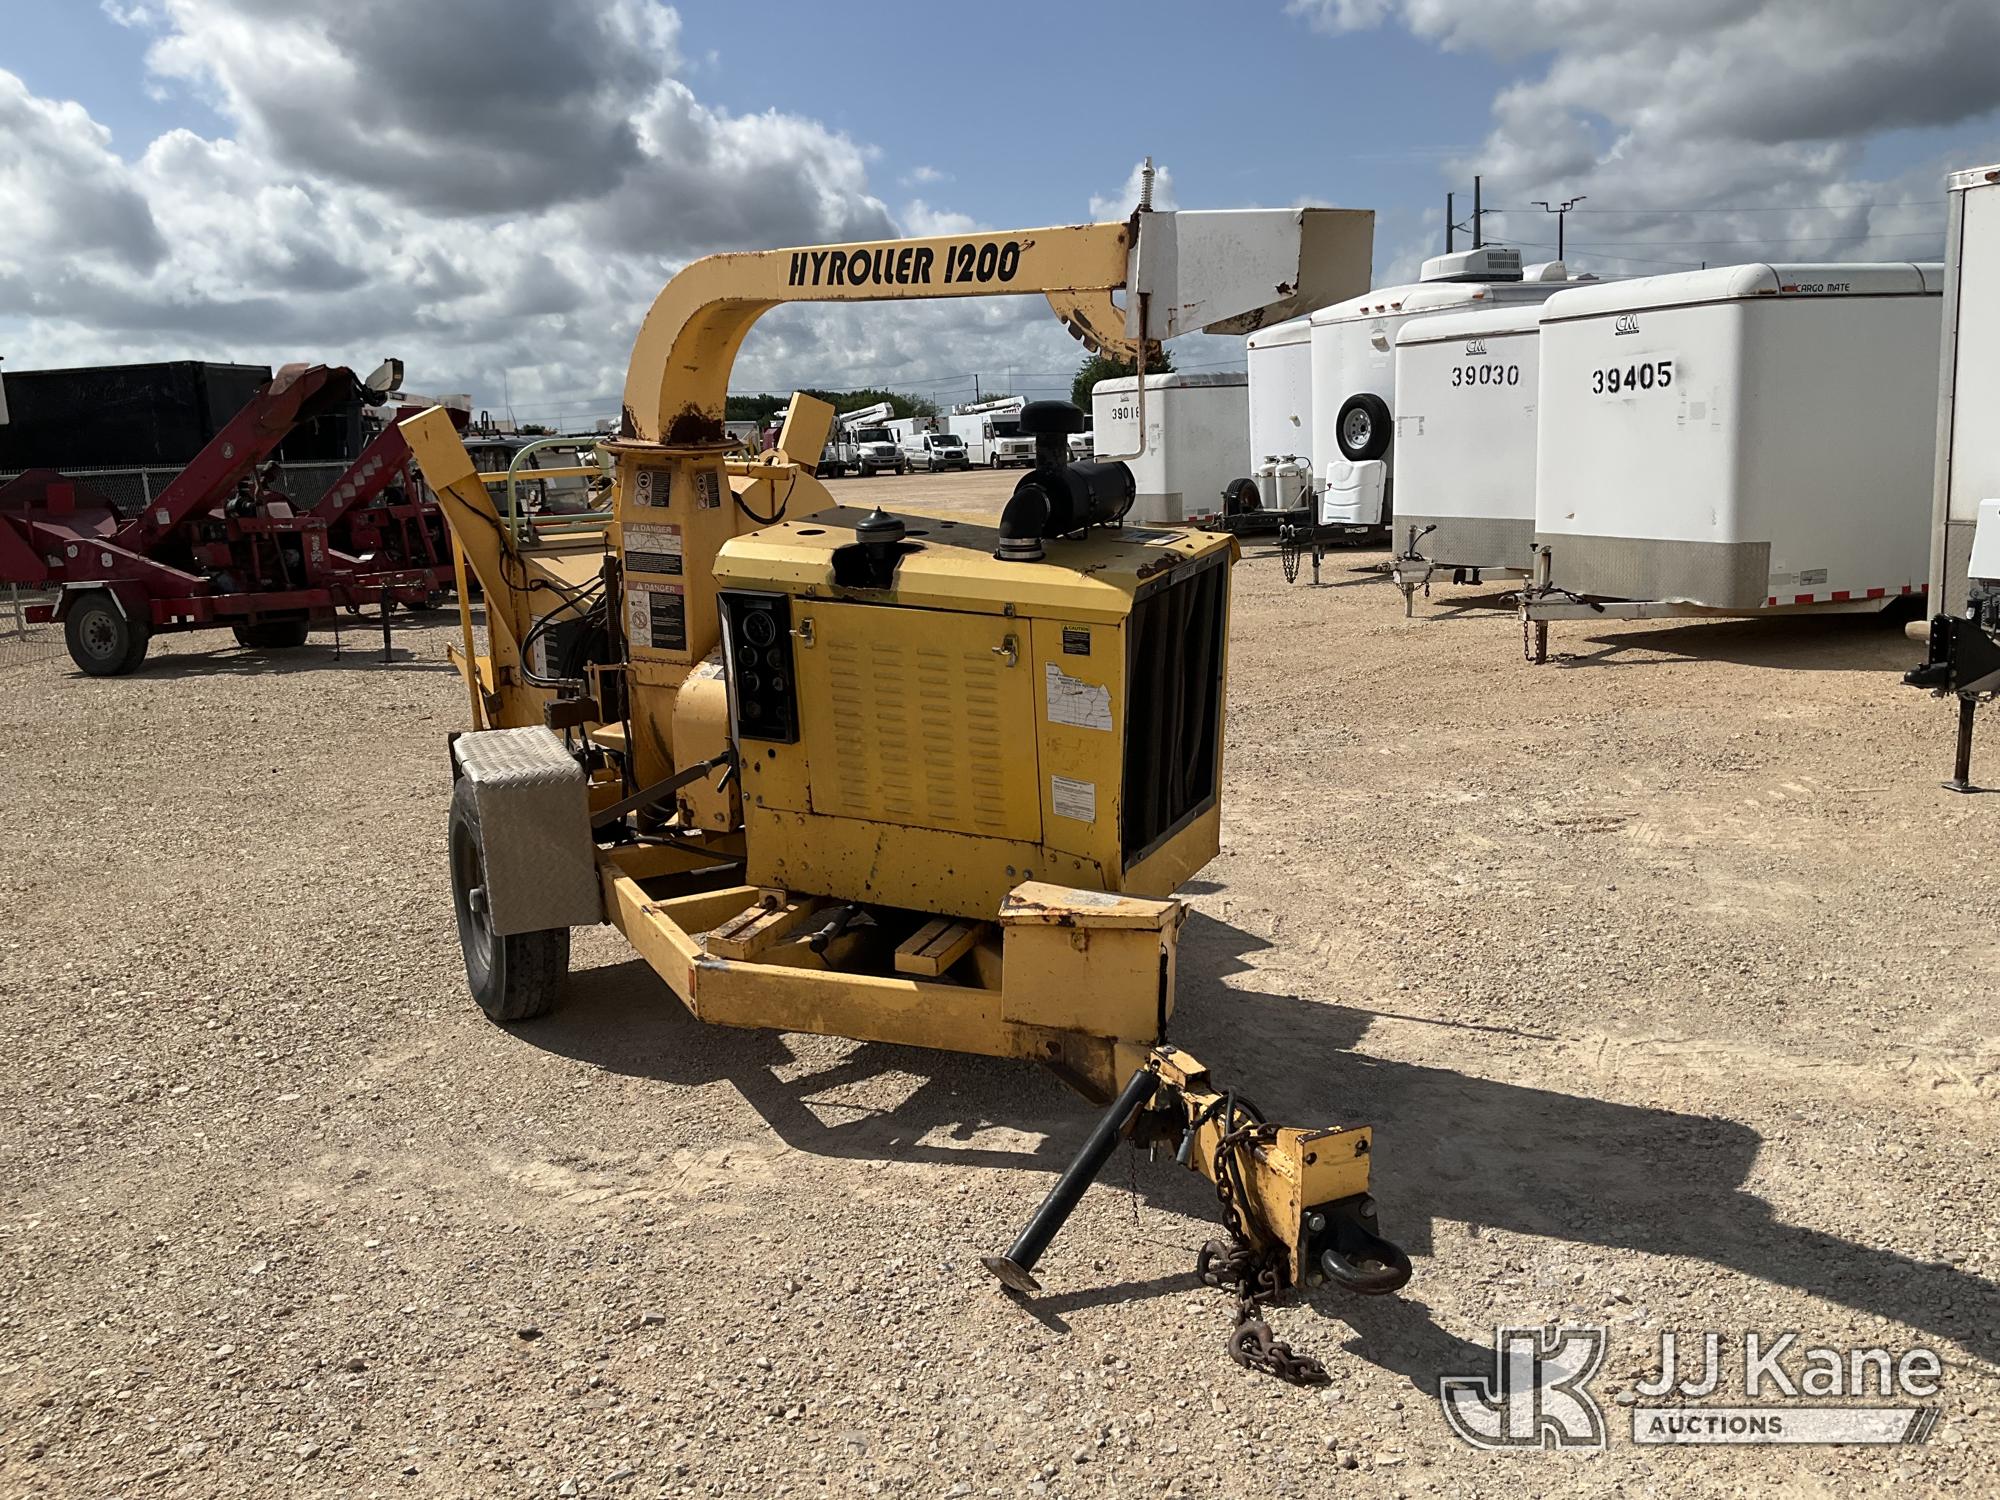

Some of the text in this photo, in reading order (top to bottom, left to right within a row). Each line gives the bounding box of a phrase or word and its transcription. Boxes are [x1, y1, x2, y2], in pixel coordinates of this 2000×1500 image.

[788, 241, 1020, 286] HYROLLER 1200
[1796, 283, 1851, 292] CARGO MATE
[1615, 314, 1638, 331] CM
[1466, 339, 1486, 352] CM
[1452, 364, 1519, 386] 39030
[1592, 361, 1672, 394] 39405
[640, 524, 672, 534] DANGER
[644, 583, 675, 593] DANGER
